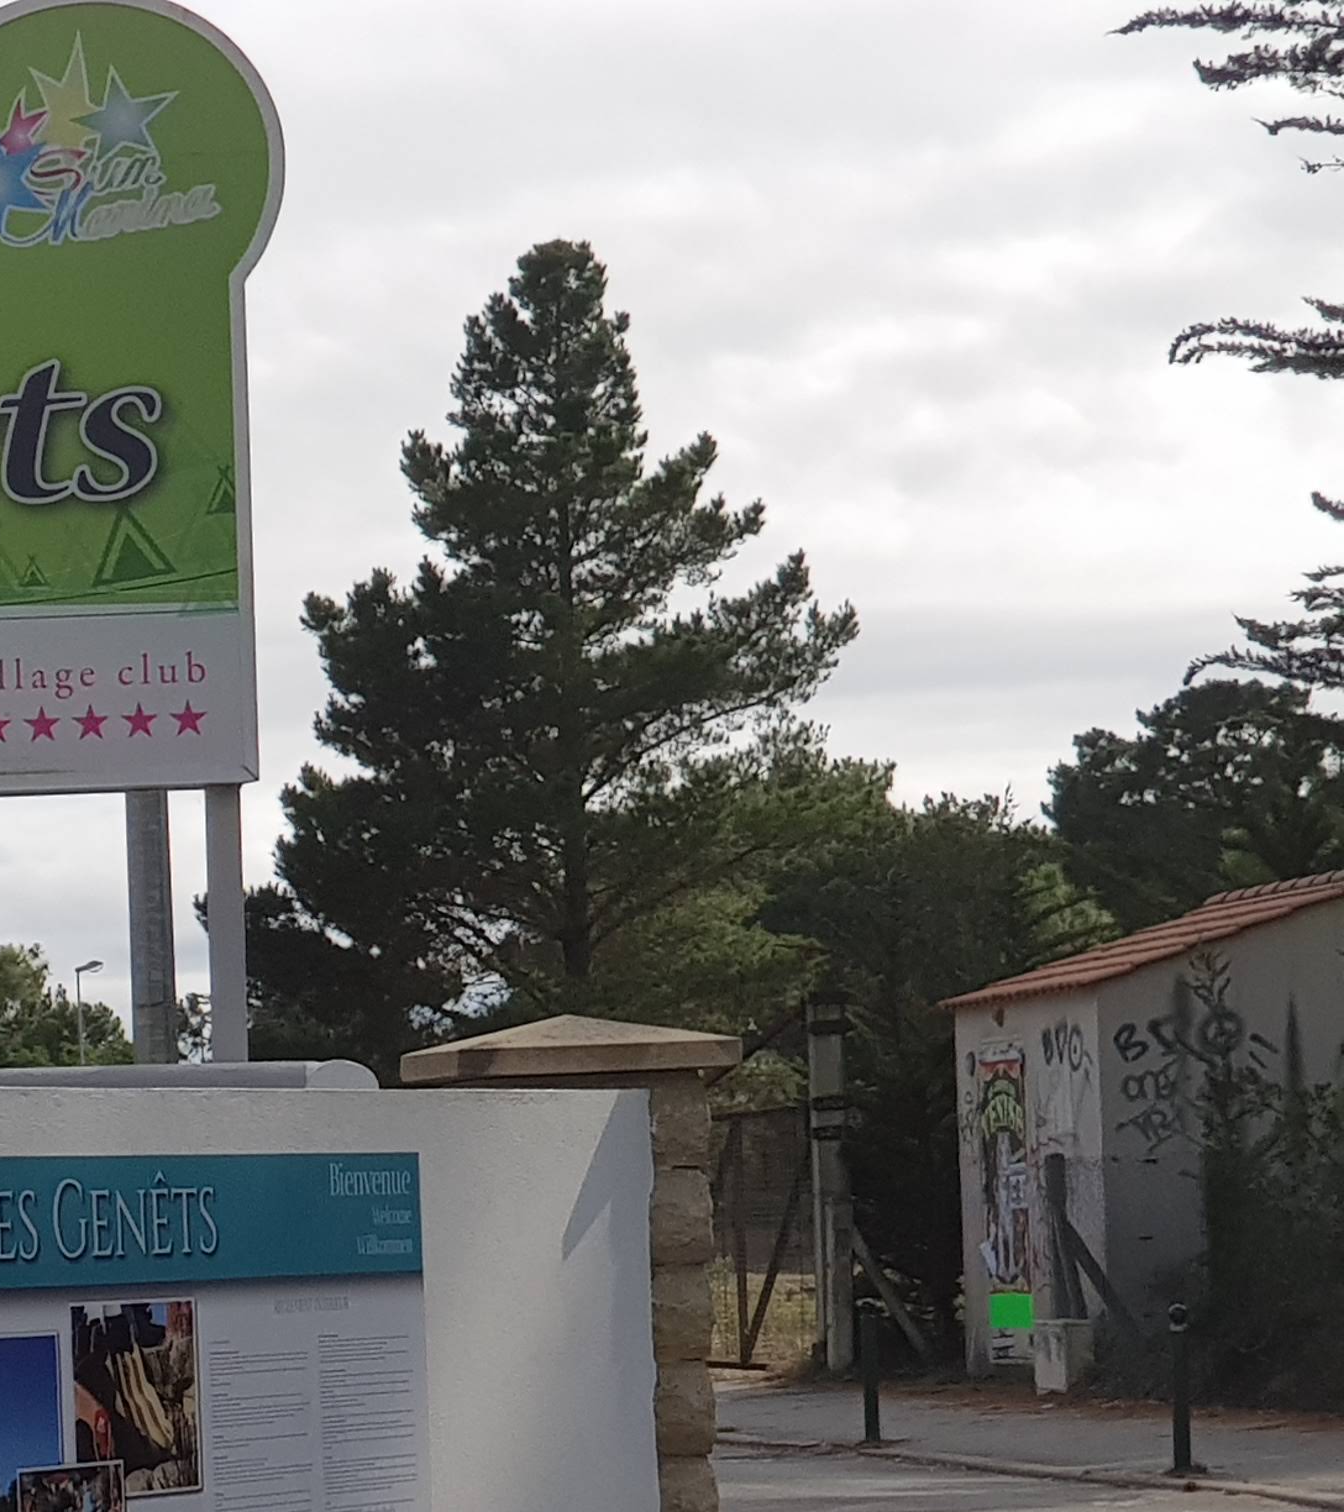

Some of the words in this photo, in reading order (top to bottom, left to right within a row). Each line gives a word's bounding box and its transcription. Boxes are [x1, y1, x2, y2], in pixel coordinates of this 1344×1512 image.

[120, 653, 208, 688] club
[330, 1163, 410, 1196] Bienvenue
[53, 1171, 219, 1260] GENÊTS
